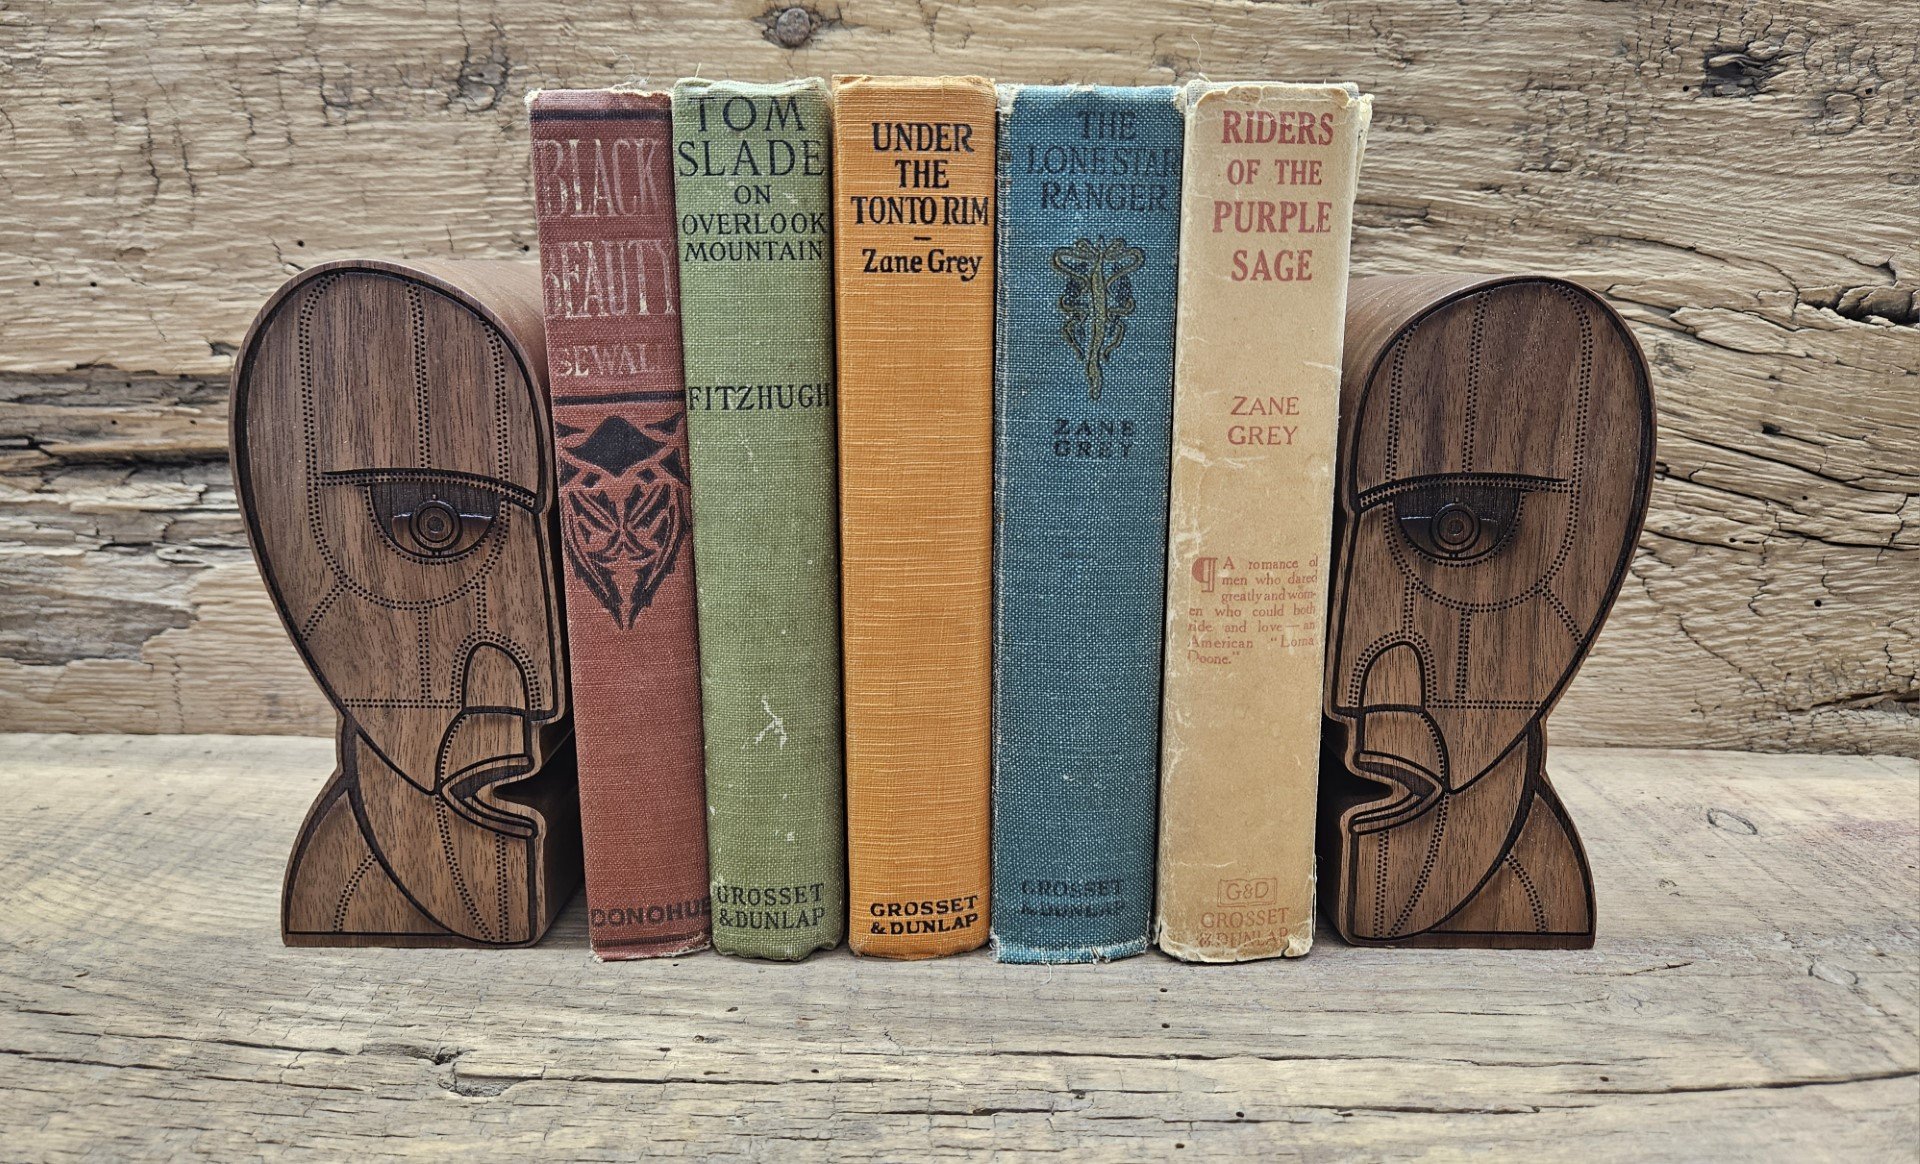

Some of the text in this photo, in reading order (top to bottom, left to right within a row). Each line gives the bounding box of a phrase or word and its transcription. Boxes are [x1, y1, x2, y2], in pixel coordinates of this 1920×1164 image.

[688, 96, 806, 132] TOM
[1077, 110, 1137, 139] THE
[871, 123, 975, 153] UNDER
[1221, 110, 1334, 145] RIDERS
[678, 139, 825, 177] SLADE
[1026, 146, 1106, 174] LONE
[534, 138, 663, 217] BLACK
[895, 159, 949, 189] THE
[1227, 159, 1322, 186] OF THE
[734, 185, 771, 205] ON
[1040, 181, 1170, 211] RANGER
[851, 196, 989, 225] TONTO RIM
[1212, 200, 1332, 234] PURPLE
[682, 212, 827, 236] OVERLOOK
[684, 241, 824, 262] MOUNTAIN
[862, 249, 984, 281] Zane Grey
[1231, 249, 1313, 282] SAGE
[544, 239, 676, 318] BEAUTY
[688, 382, 831, 411] FITZHUGH
[1230, 396, 1300, 416] ZANE
[1054, 419, 1133, 437] ZANE
[1227, 426, 1298, 445] GREY
[1053, 440, 1134, 459] GREY
[1223, 556, 1235, 570] A
[1248, 560, 1299, 570] romance
[1222, 570, 1318, 586] men who dared
[1221, 588, 1262, 604] greatly
[1264, 588, 1286, 601] and
[1189, 602, 1316, 617] en who could both
[1187, 619, 1213, 632] ride
[1224, 620, 1247, 633] and
[1258, 620, 1282, 632] love
[1303, 621, 1315, 630] an
[1189, 635, 1254, 648] American
[717, 882, 825, 907] GROSSET
[1020, 878, 1123, 898] GROSSET
[1226, 881, 1269, 900] G&D
[870, 895, 978, 917] GROSSET
[1201, 907, 1289, 928] GROSSET
